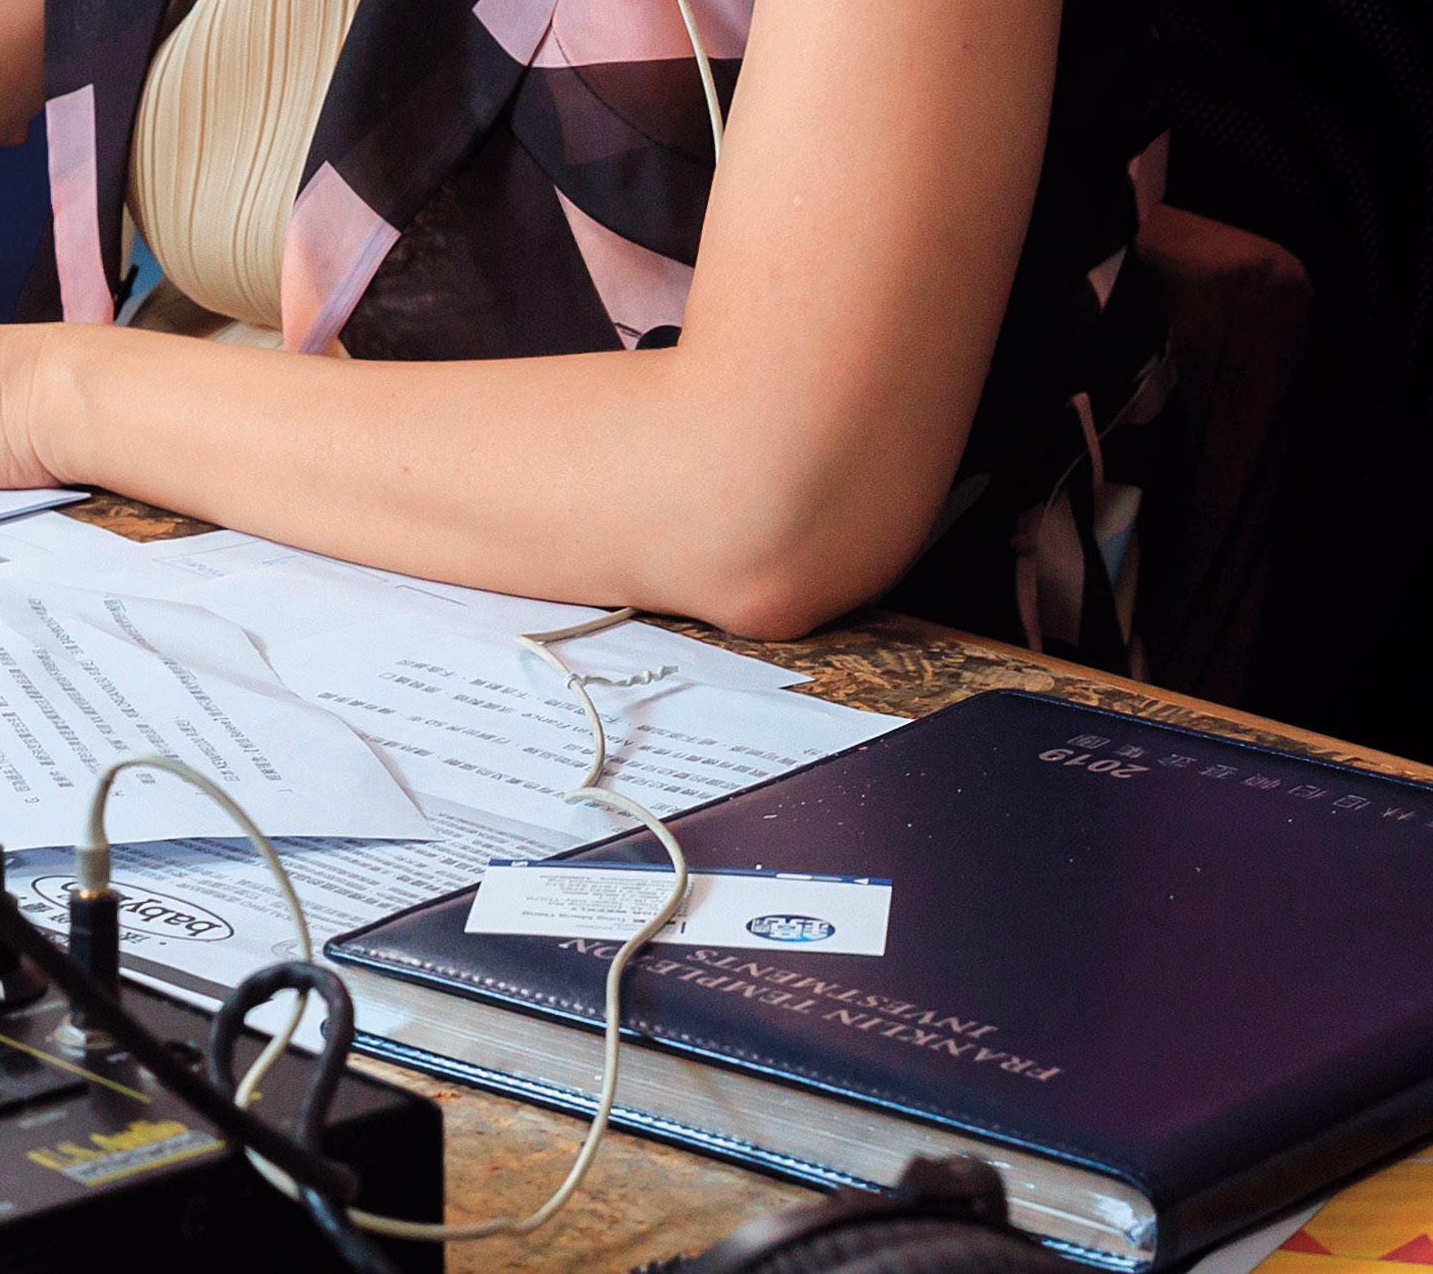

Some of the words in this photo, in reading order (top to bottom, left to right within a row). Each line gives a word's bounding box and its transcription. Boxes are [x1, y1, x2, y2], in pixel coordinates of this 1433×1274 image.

[519, 711, 571, 732] France
[1034, 744, 1151, 783] 2019
[560, 935, 820, 1014] TEMPLEON
[684, 948, 1000, 1039] INVESTMENTS
[821, 1000, 1065, 1085] FRANKLIN
